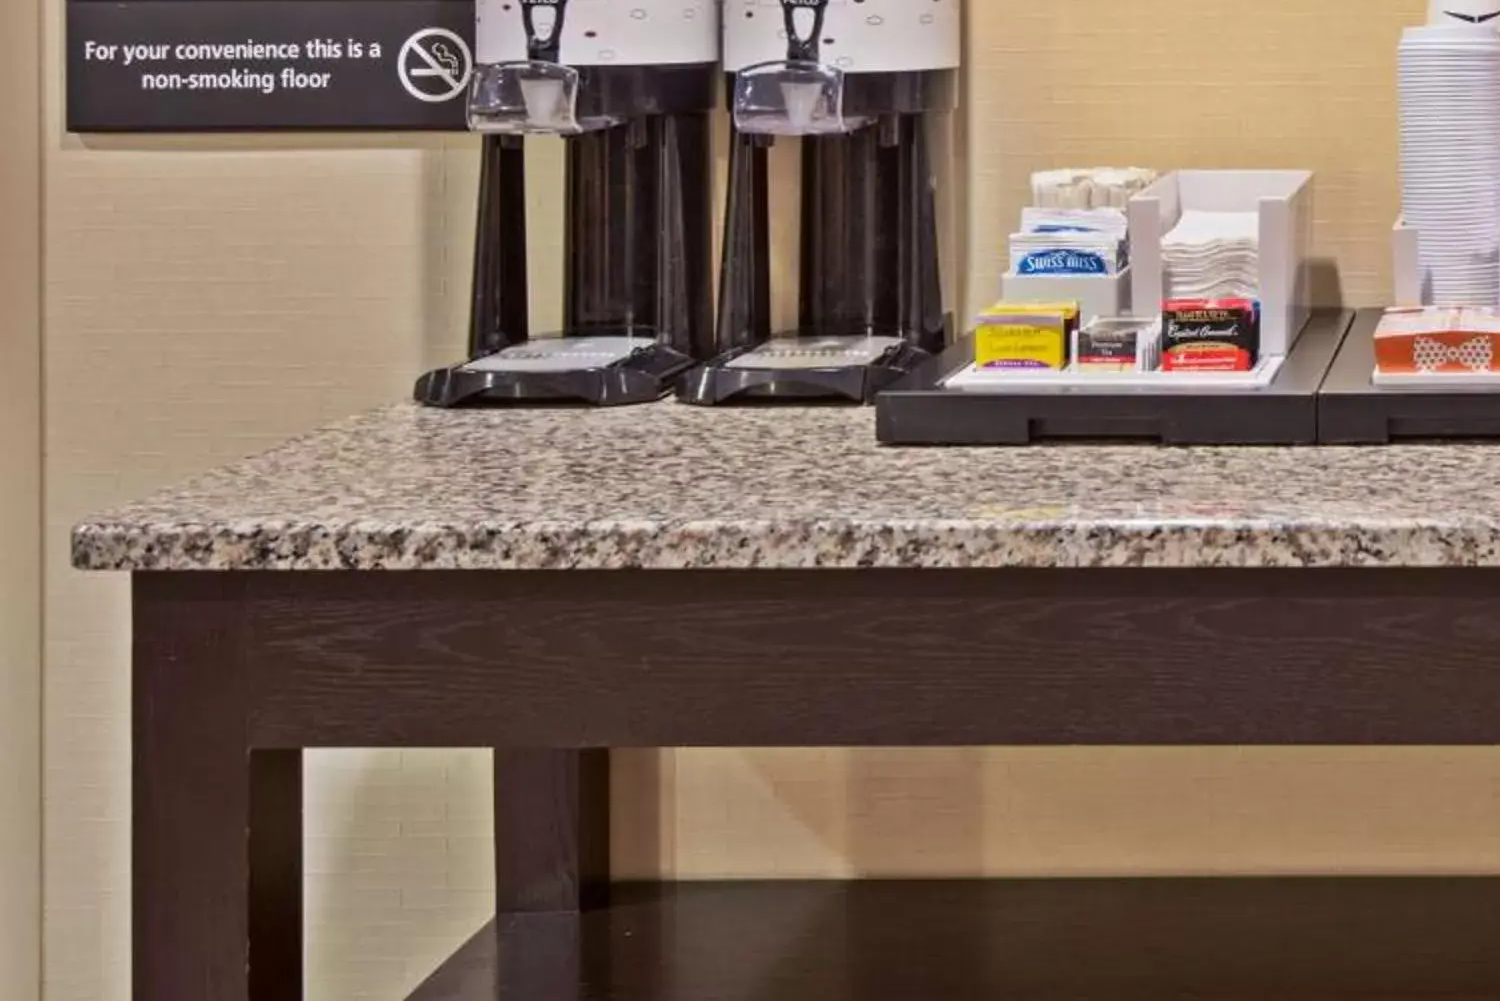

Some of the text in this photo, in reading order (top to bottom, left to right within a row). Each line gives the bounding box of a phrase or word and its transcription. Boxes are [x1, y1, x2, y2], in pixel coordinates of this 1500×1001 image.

[84, 40, 382, 67] For your convenience this is a
[142, 68, 331, 95] non-smoking floor
